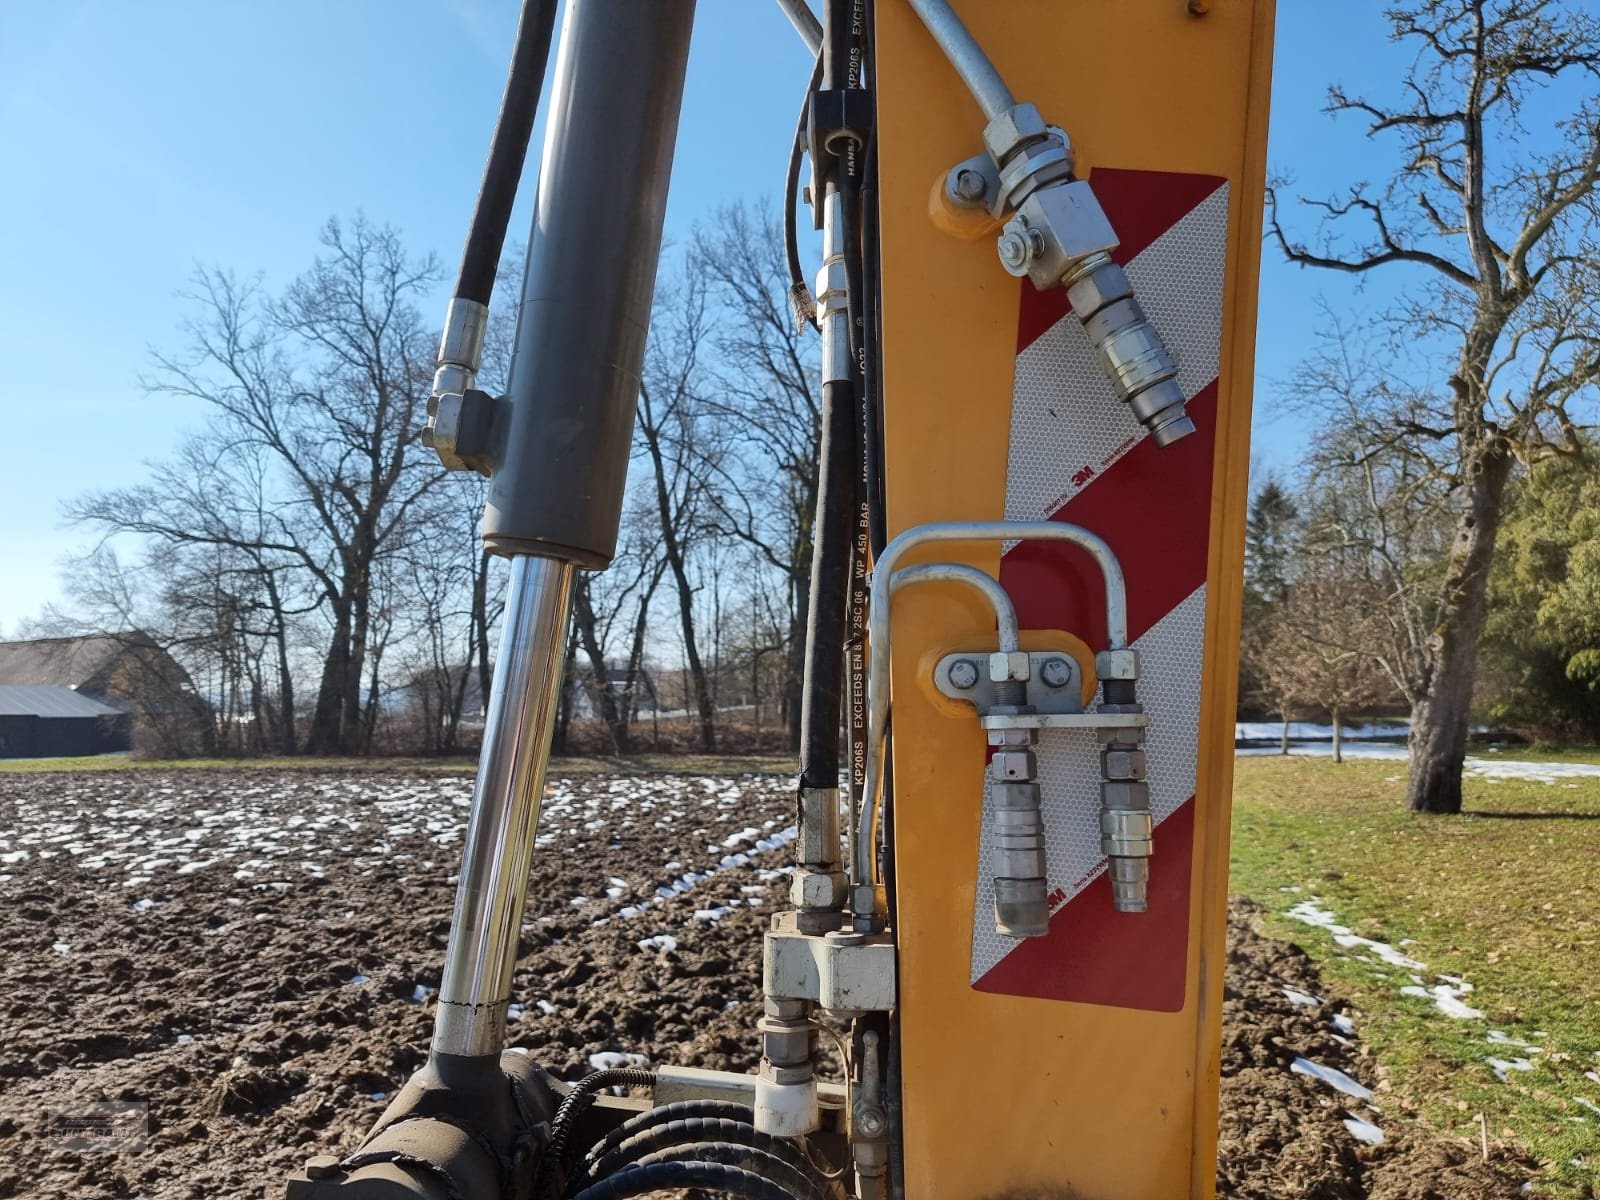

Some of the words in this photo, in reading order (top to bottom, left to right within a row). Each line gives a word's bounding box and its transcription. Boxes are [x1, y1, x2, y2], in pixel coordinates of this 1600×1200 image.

[847, 47, 860, 90] KP206S
[1071, 464, 1095, 487] 3M
[859, 502, 870, 528] BAR
[857, 534, 867, 554] 450
[855, 560, 865, 579] WP
[854, 591, 863, 604] 06
[853, 607, 862, 629] 2SC
[853, 632, 862, 651] 87
[853, 654, 862, 670] EN
[853, 673, 863, 728] EXCEEDS
[854, 741, 864, 785] KP206S
